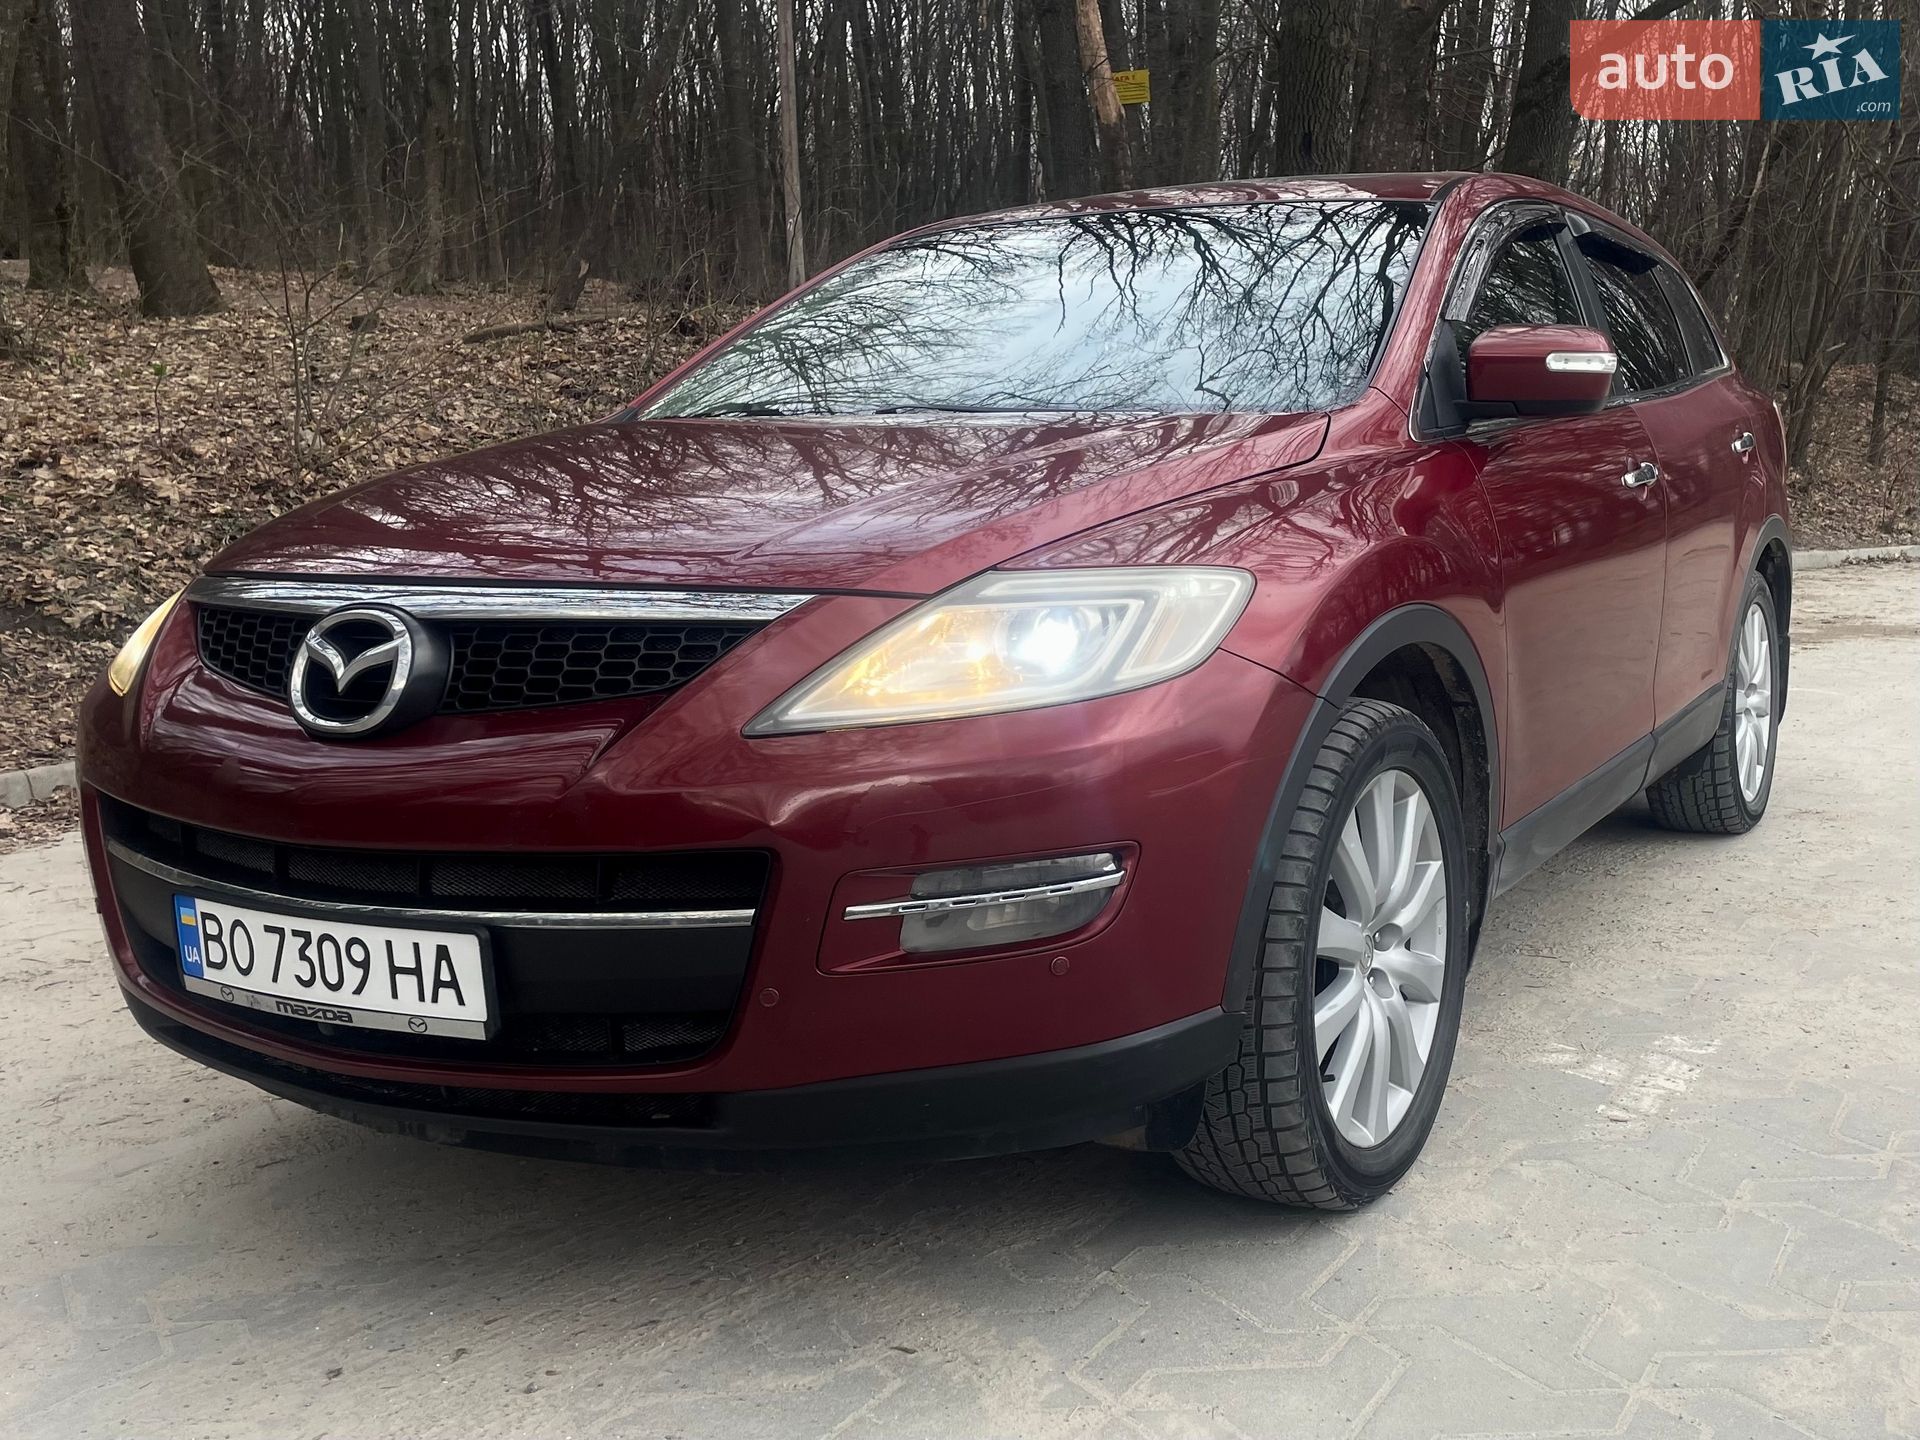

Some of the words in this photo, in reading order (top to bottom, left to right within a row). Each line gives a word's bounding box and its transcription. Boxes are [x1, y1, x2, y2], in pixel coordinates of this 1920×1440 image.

[185, 944, 200, 964] UA
[200, 911, 254, 976] BO
[263, 924, 371, 996] 7309
[385, 939, 466, 1006] HA
